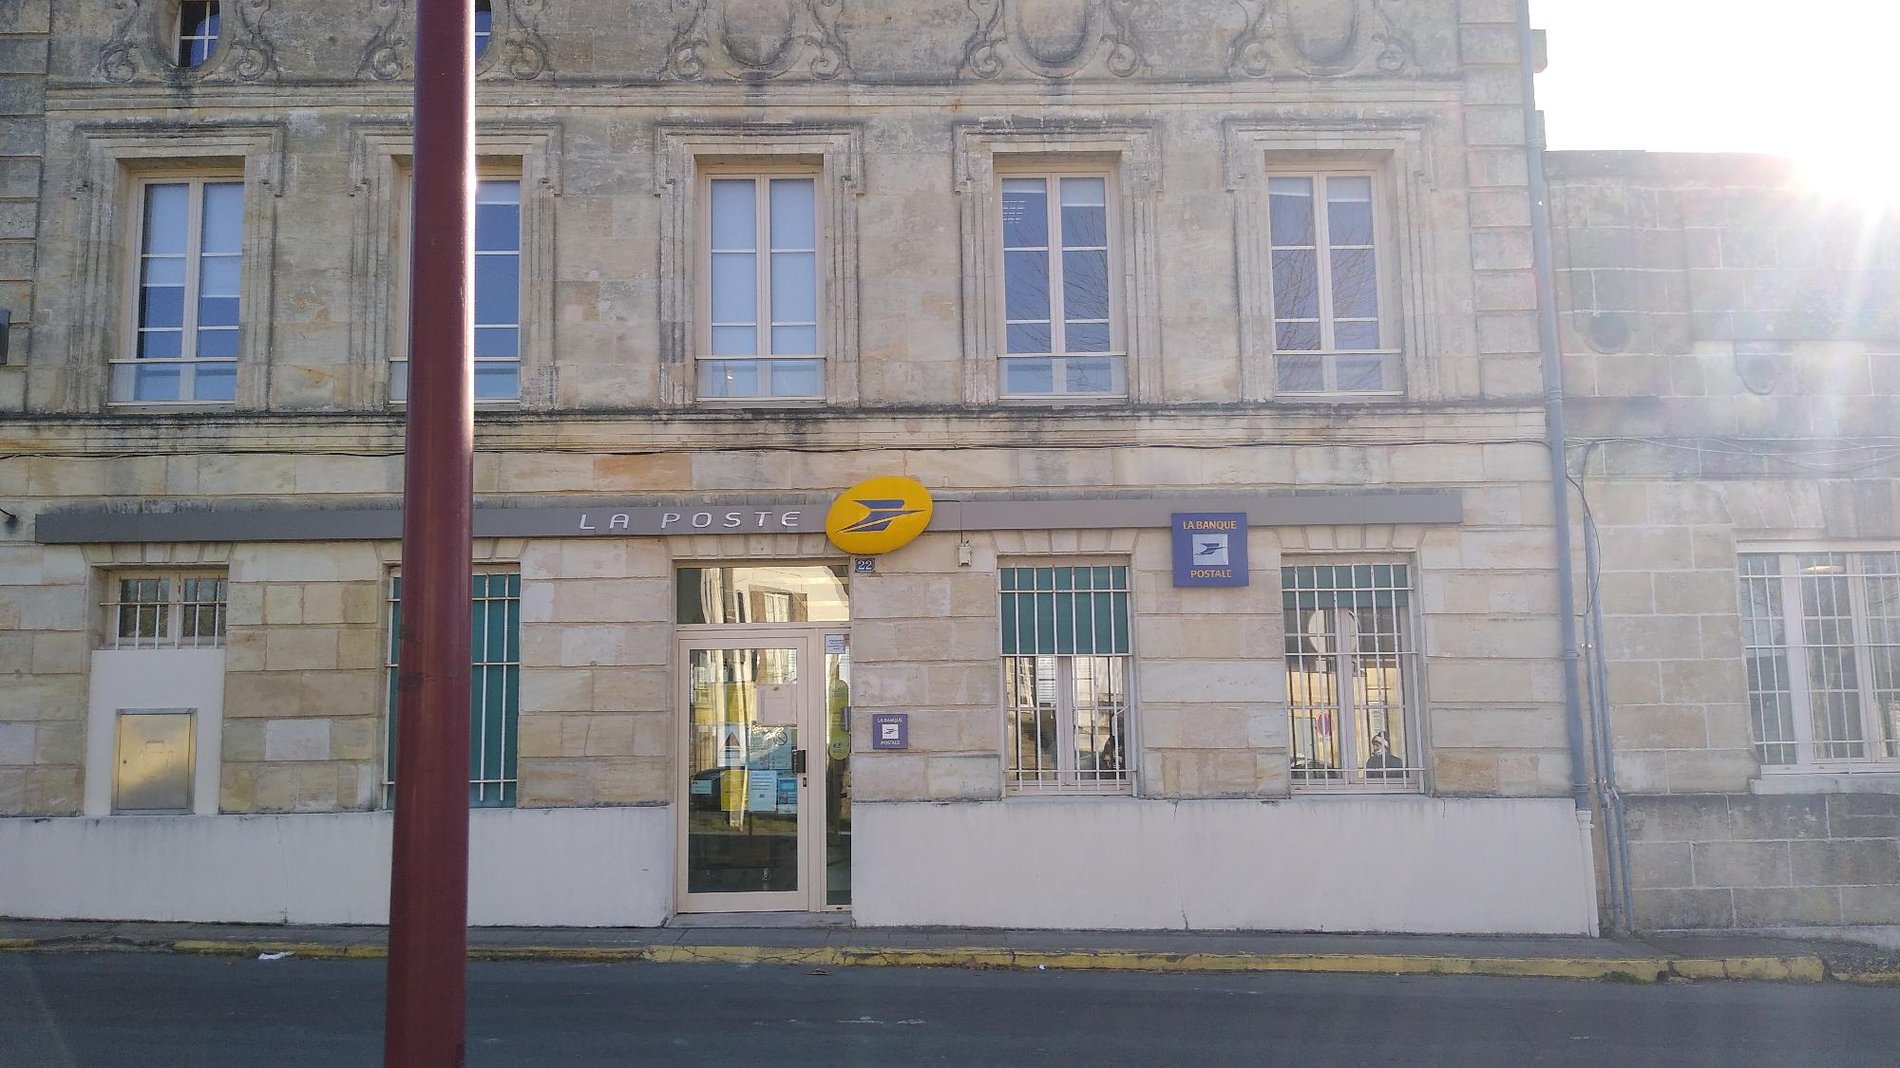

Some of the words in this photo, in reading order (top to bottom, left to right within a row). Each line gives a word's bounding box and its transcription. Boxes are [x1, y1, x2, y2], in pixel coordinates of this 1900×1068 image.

[579, 513, 631, 530] LA
[660, 511, 801, 529] POSTE
[1183, 521, 1195, 530] LA
[1196, 520, 1237, 531] BANQUE
[857, 559, 872, 570] 22
[1190, 569, 1232, 578] POSTALE
